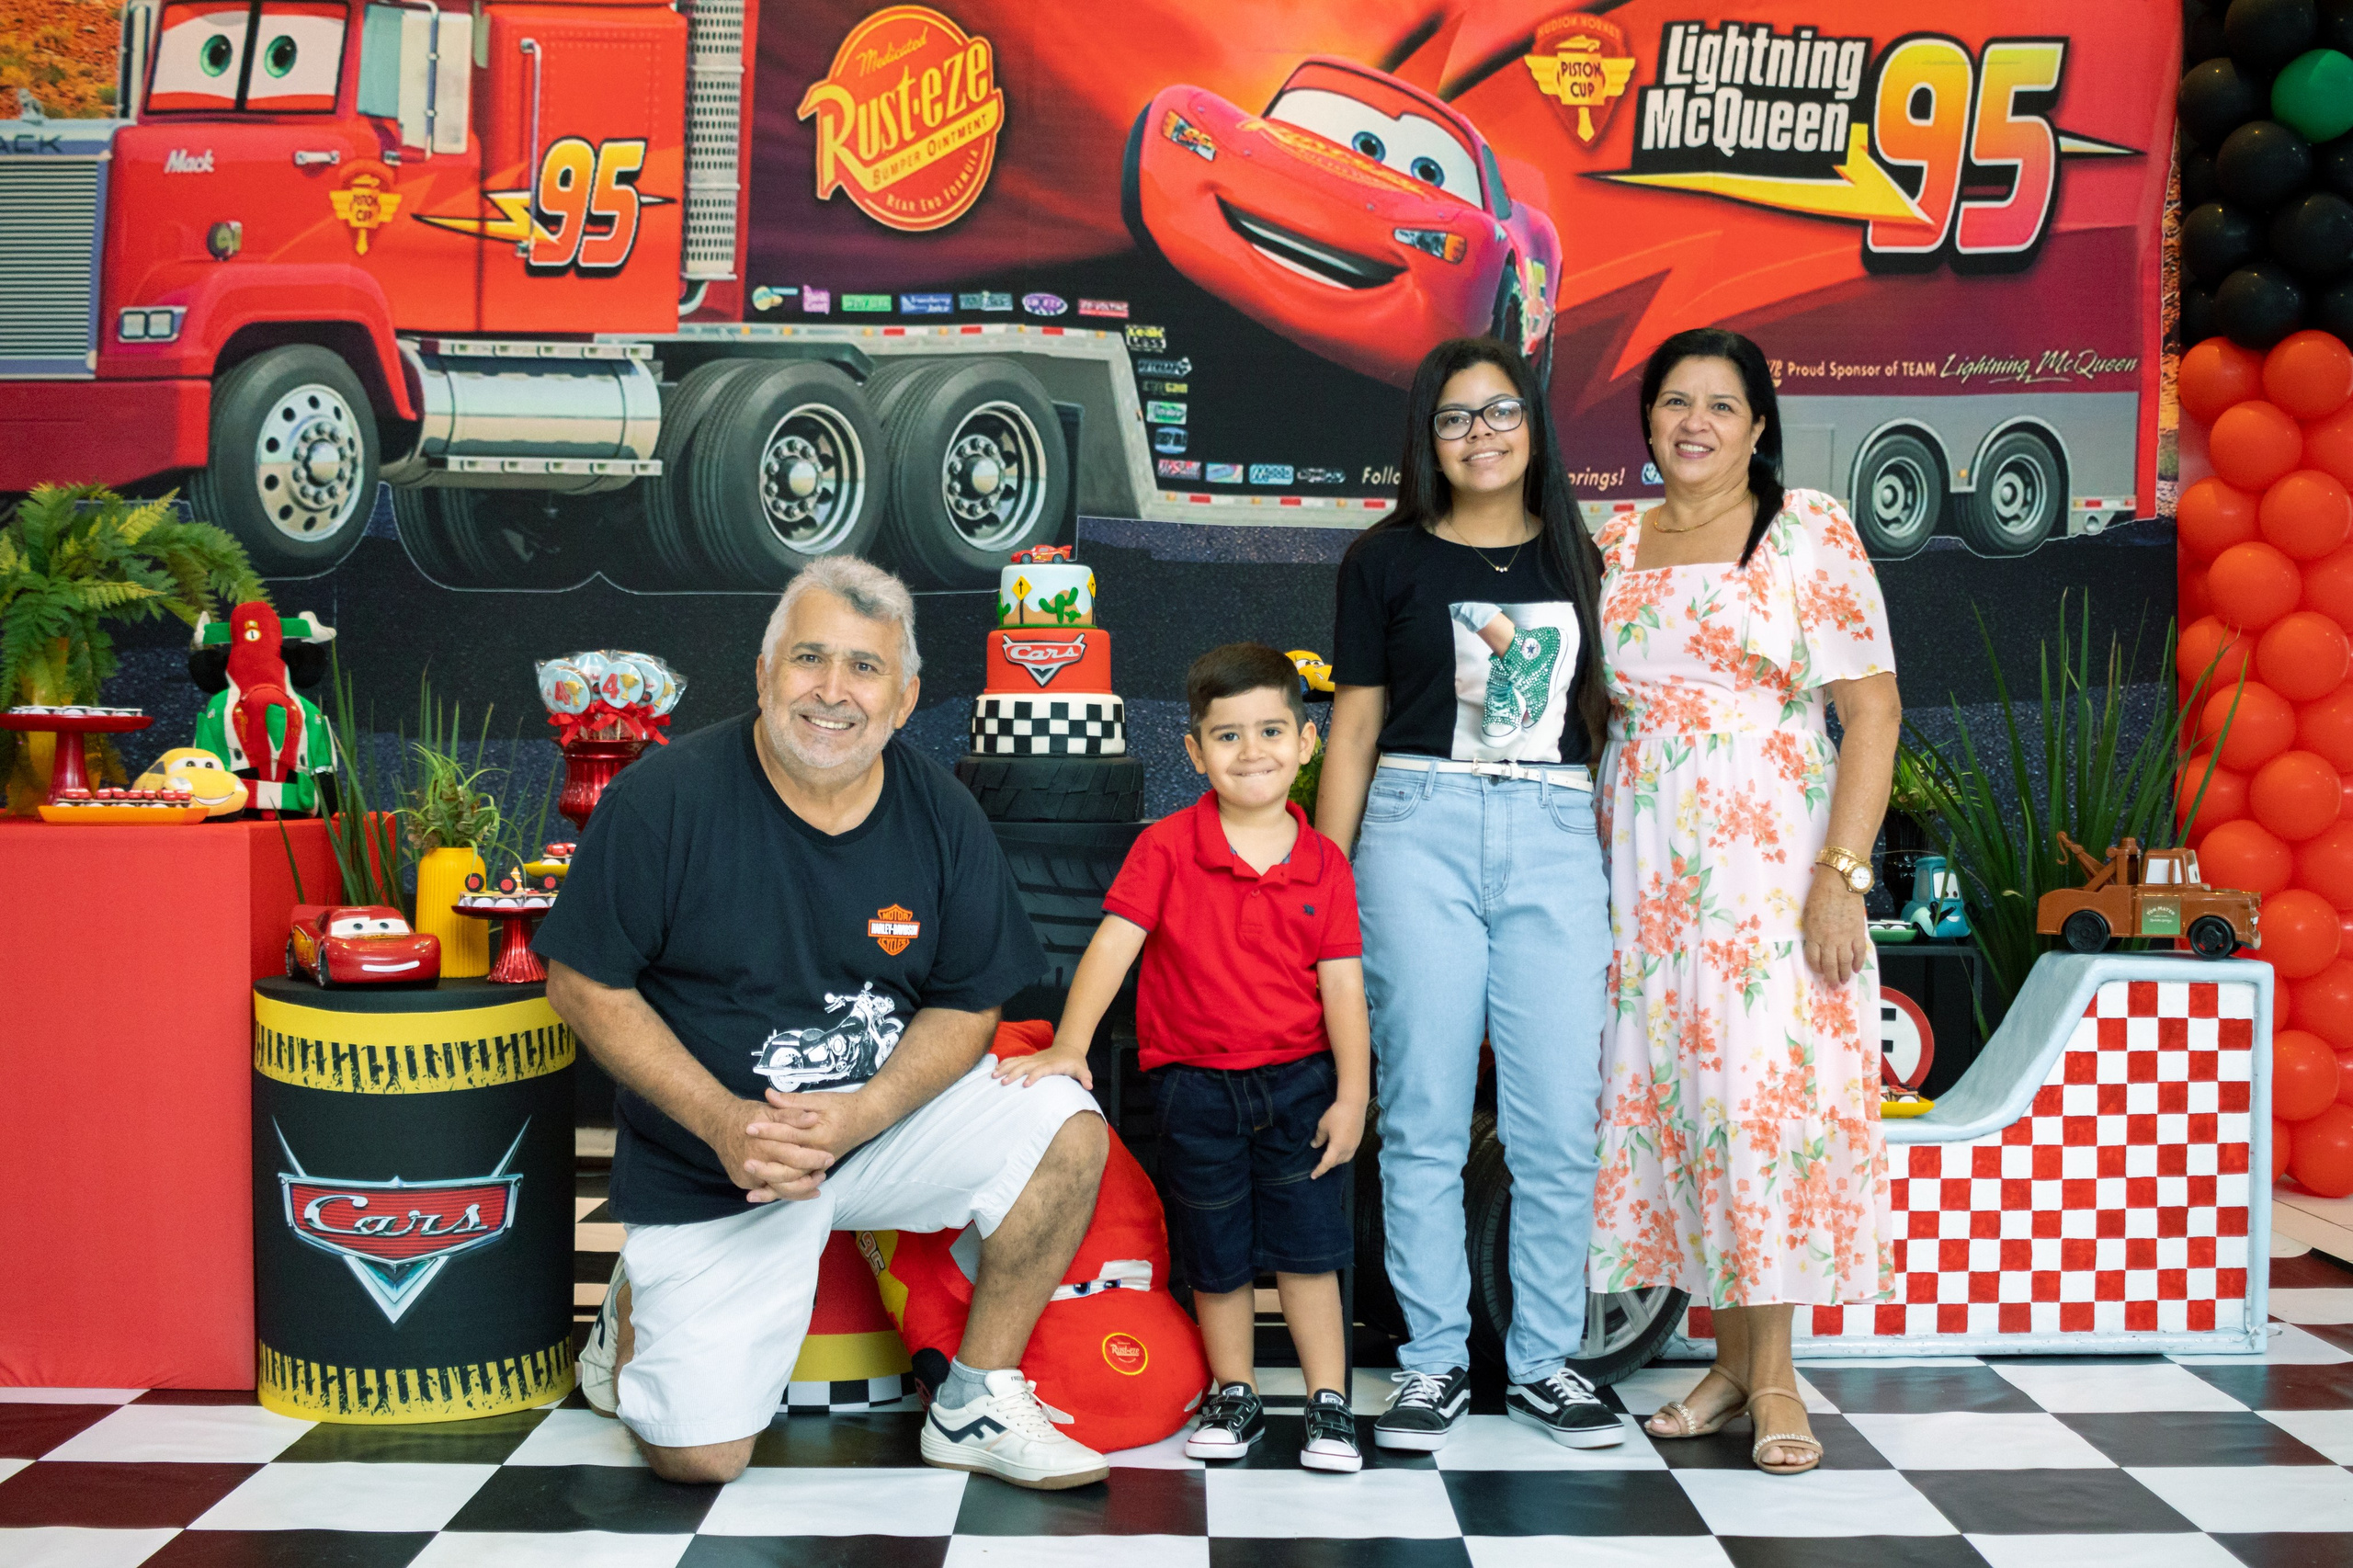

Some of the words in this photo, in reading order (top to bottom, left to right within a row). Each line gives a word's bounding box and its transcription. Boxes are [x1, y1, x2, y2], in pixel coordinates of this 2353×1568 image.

[856, 26, 928, 77] Medicated
[1664, 25, 1867, 99] Lightning
[1561, 62, 1601, 77] PISTON
[1570, 82, 1595, 97] CUP
[1642, 87, 1850, 156] McQueen
[165, 149, 214, 174] Mack
[1867, 38, 2064, 255] 95
[529, 139, 646, 267] 95
[1788, 361, 1825, 377] Proud
[1830, 361, 1881, 381] Sponsor
[1884, 360, 1899, 377] of
[1902, 361, 1937, 377] TEAM
[1940, 353, 2030, 384] Lightning
[2035, 349, 2138, 380] McQueen
[1010, 646, 1079, 661] Cars
[554, 680, 572, 705] 4
[602, 673, 620, 699] 4
[882, 908, 908, 921] MOTOR
[304, 1194, 489, 1236] Cars
